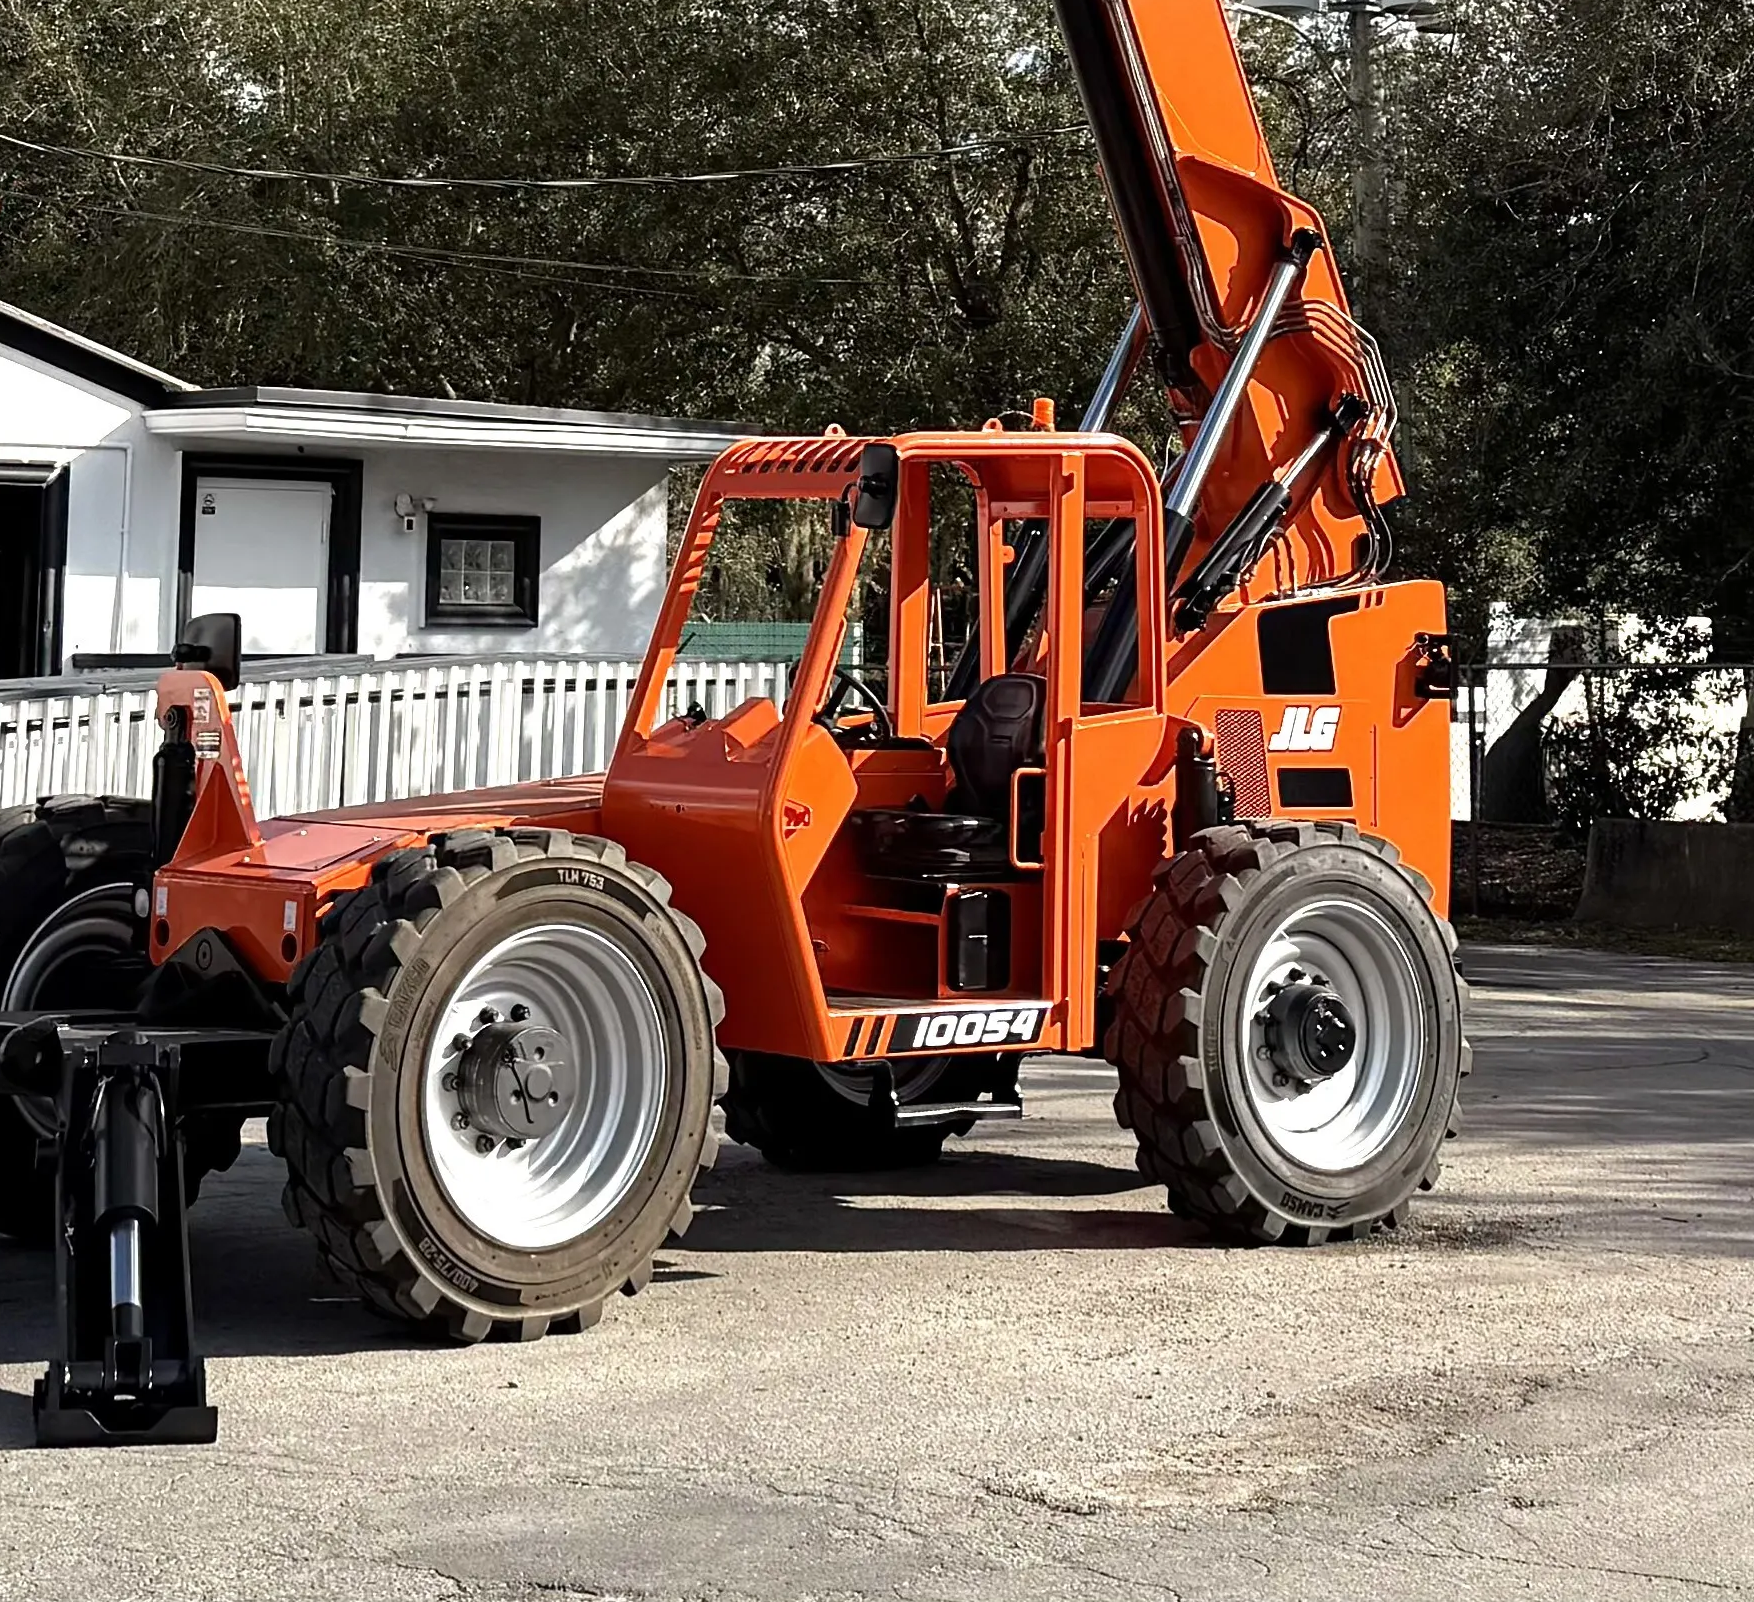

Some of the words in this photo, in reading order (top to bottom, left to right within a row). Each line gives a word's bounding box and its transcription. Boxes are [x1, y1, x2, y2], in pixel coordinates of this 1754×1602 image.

[1267, 705, 1342, 753] JLG
[581, 871, 605, 891] 753
[912, 1009, 1039, 1049] 10054
